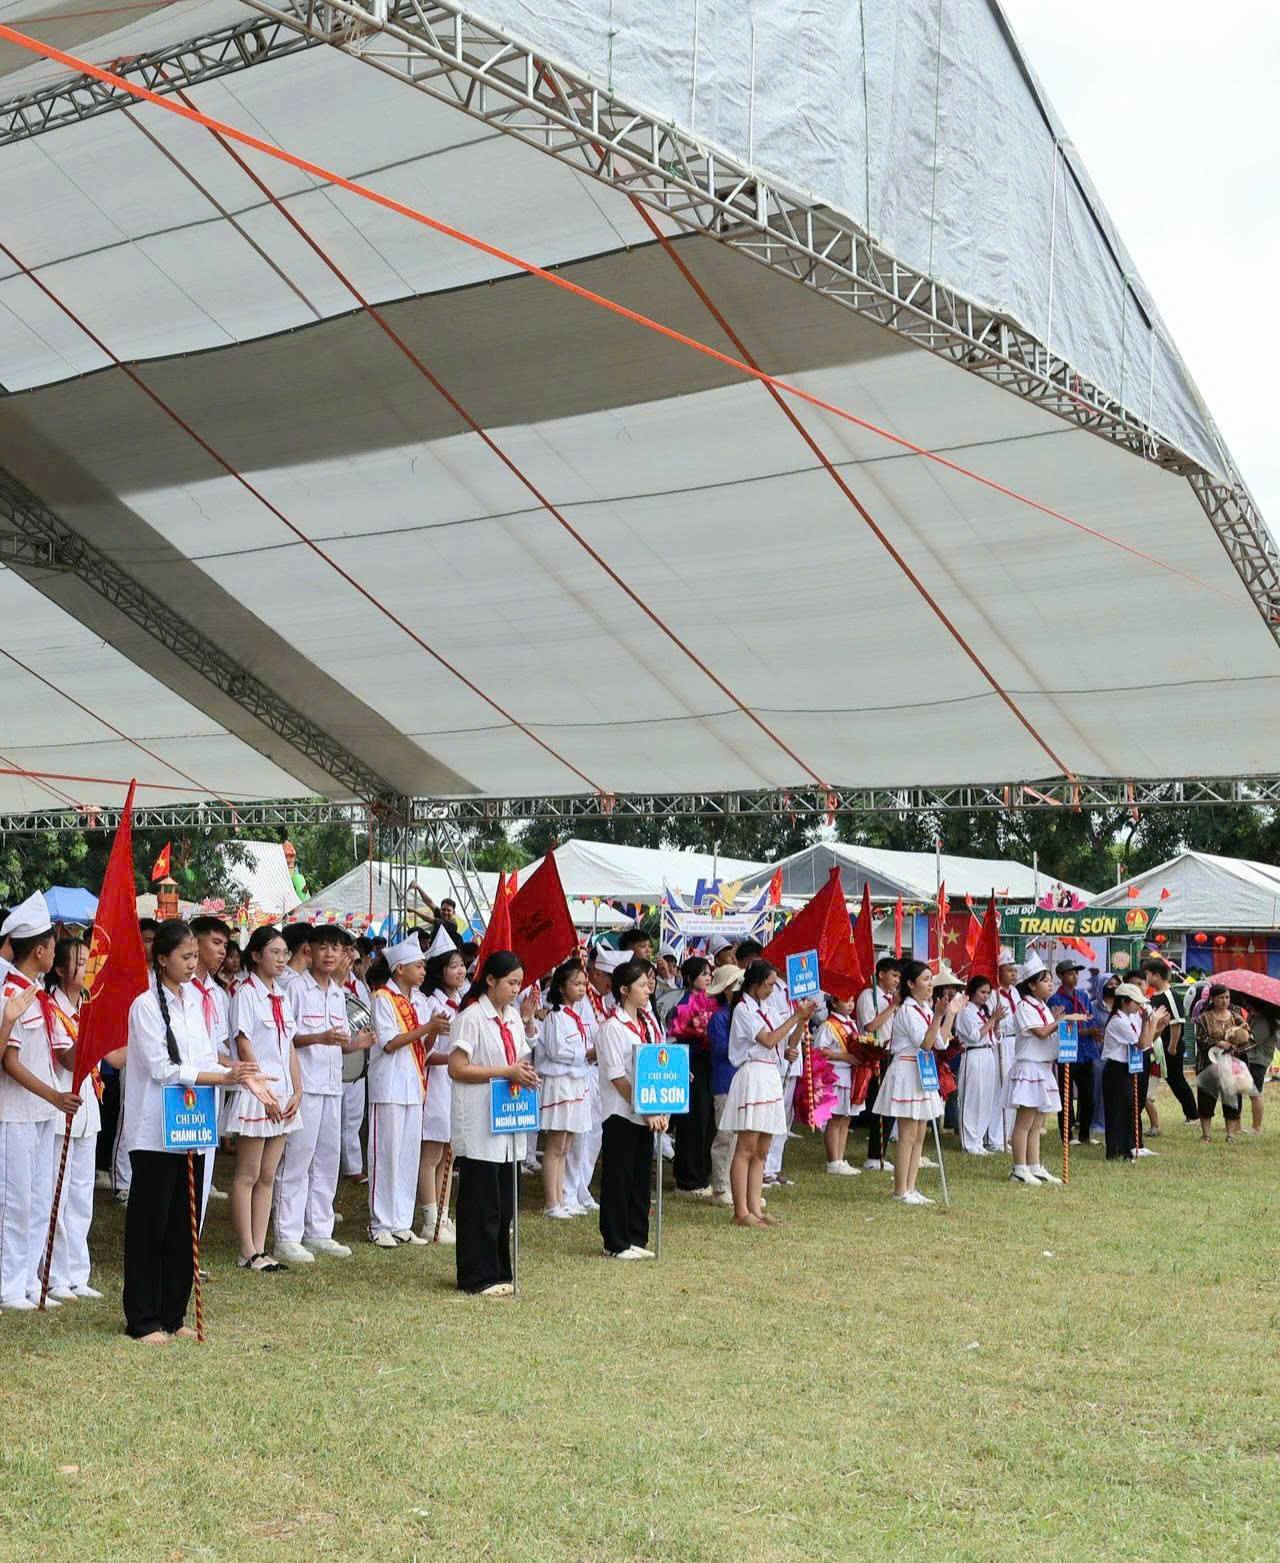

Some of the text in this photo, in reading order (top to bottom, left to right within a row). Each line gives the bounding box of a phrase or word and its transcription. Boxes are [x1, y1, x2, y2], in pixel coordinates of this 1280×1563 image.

[1005, 906, 1019, 916] CHI
[1080, 915, 1118, 934] SƠN
[648, 1070, 677, 1081] CHI ĐỘI
[660, 1086, 685, 1104] SƠN
[502, 1099, 529, 1113] CHI ĐỘI
[175, 1111, 206, 1126] CHI ĐỘI
[198, 1127, 213, 1143] LỘC
